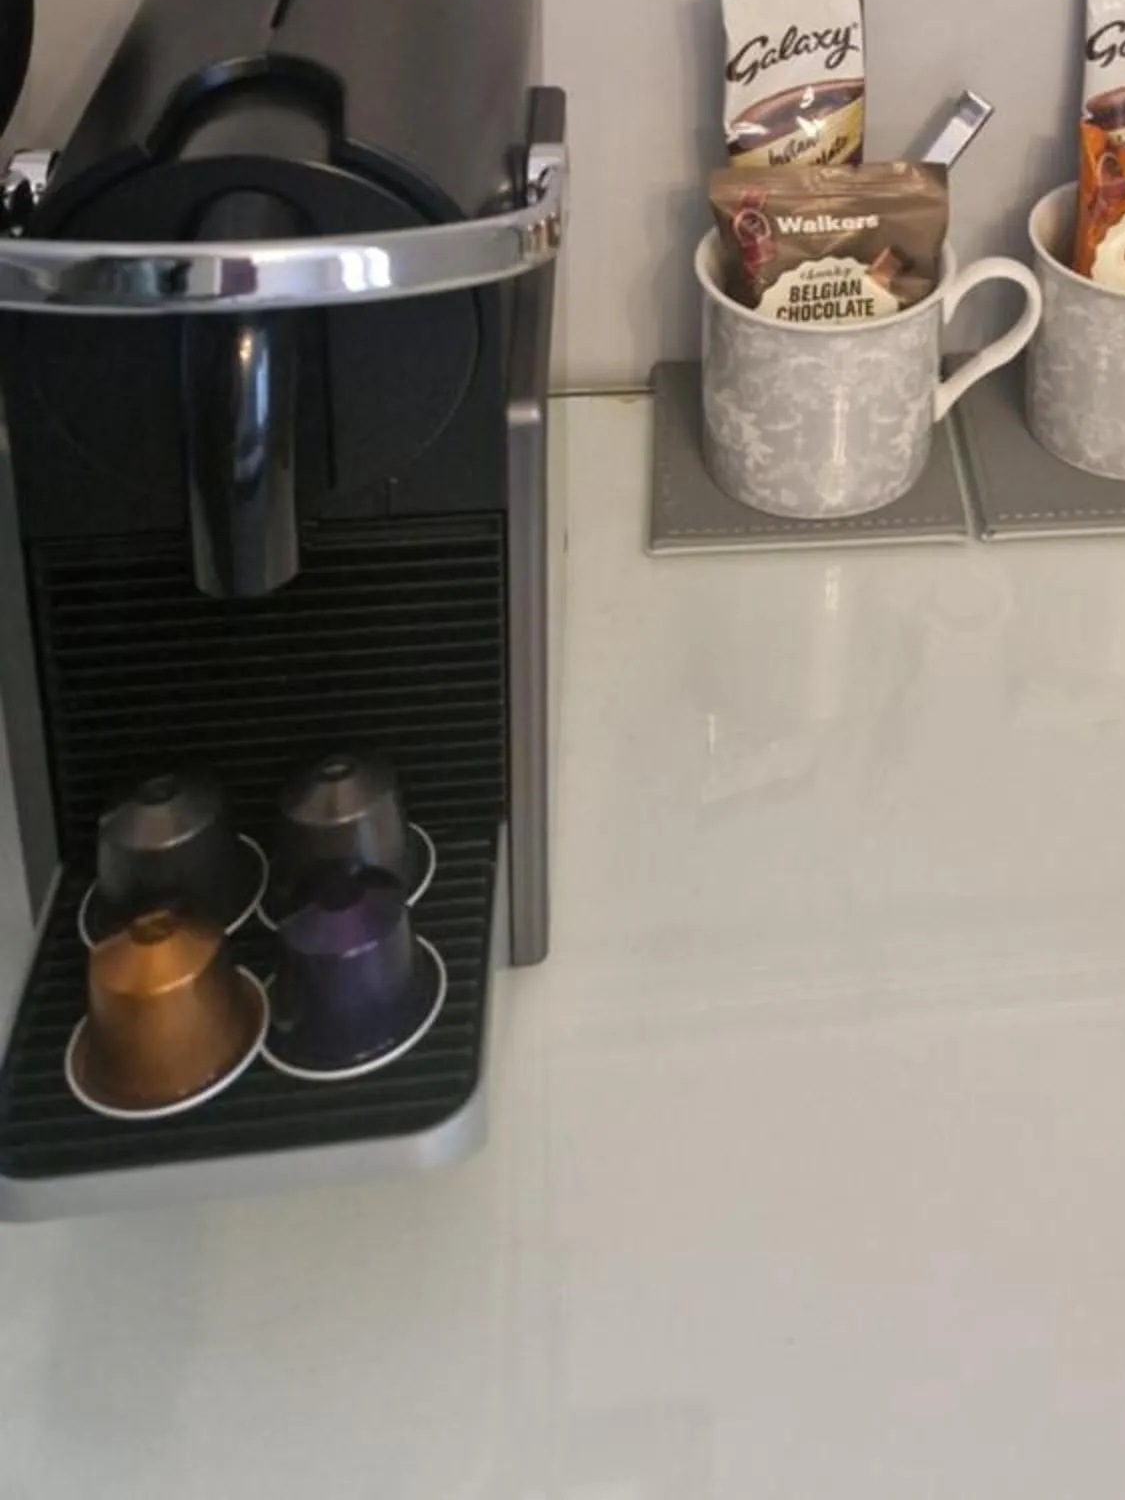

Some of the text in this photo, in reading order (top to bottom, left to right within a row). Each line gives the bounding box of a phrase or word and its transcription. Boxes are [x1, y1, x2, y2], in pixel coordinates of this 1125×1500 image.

[725, 25, 860, 85] Galaxy
[776, 213, 880, 235] Walkers
[790, 279, 862, 303] BELGIAN
[776, 298, 875, 323] CHOCOLATE
